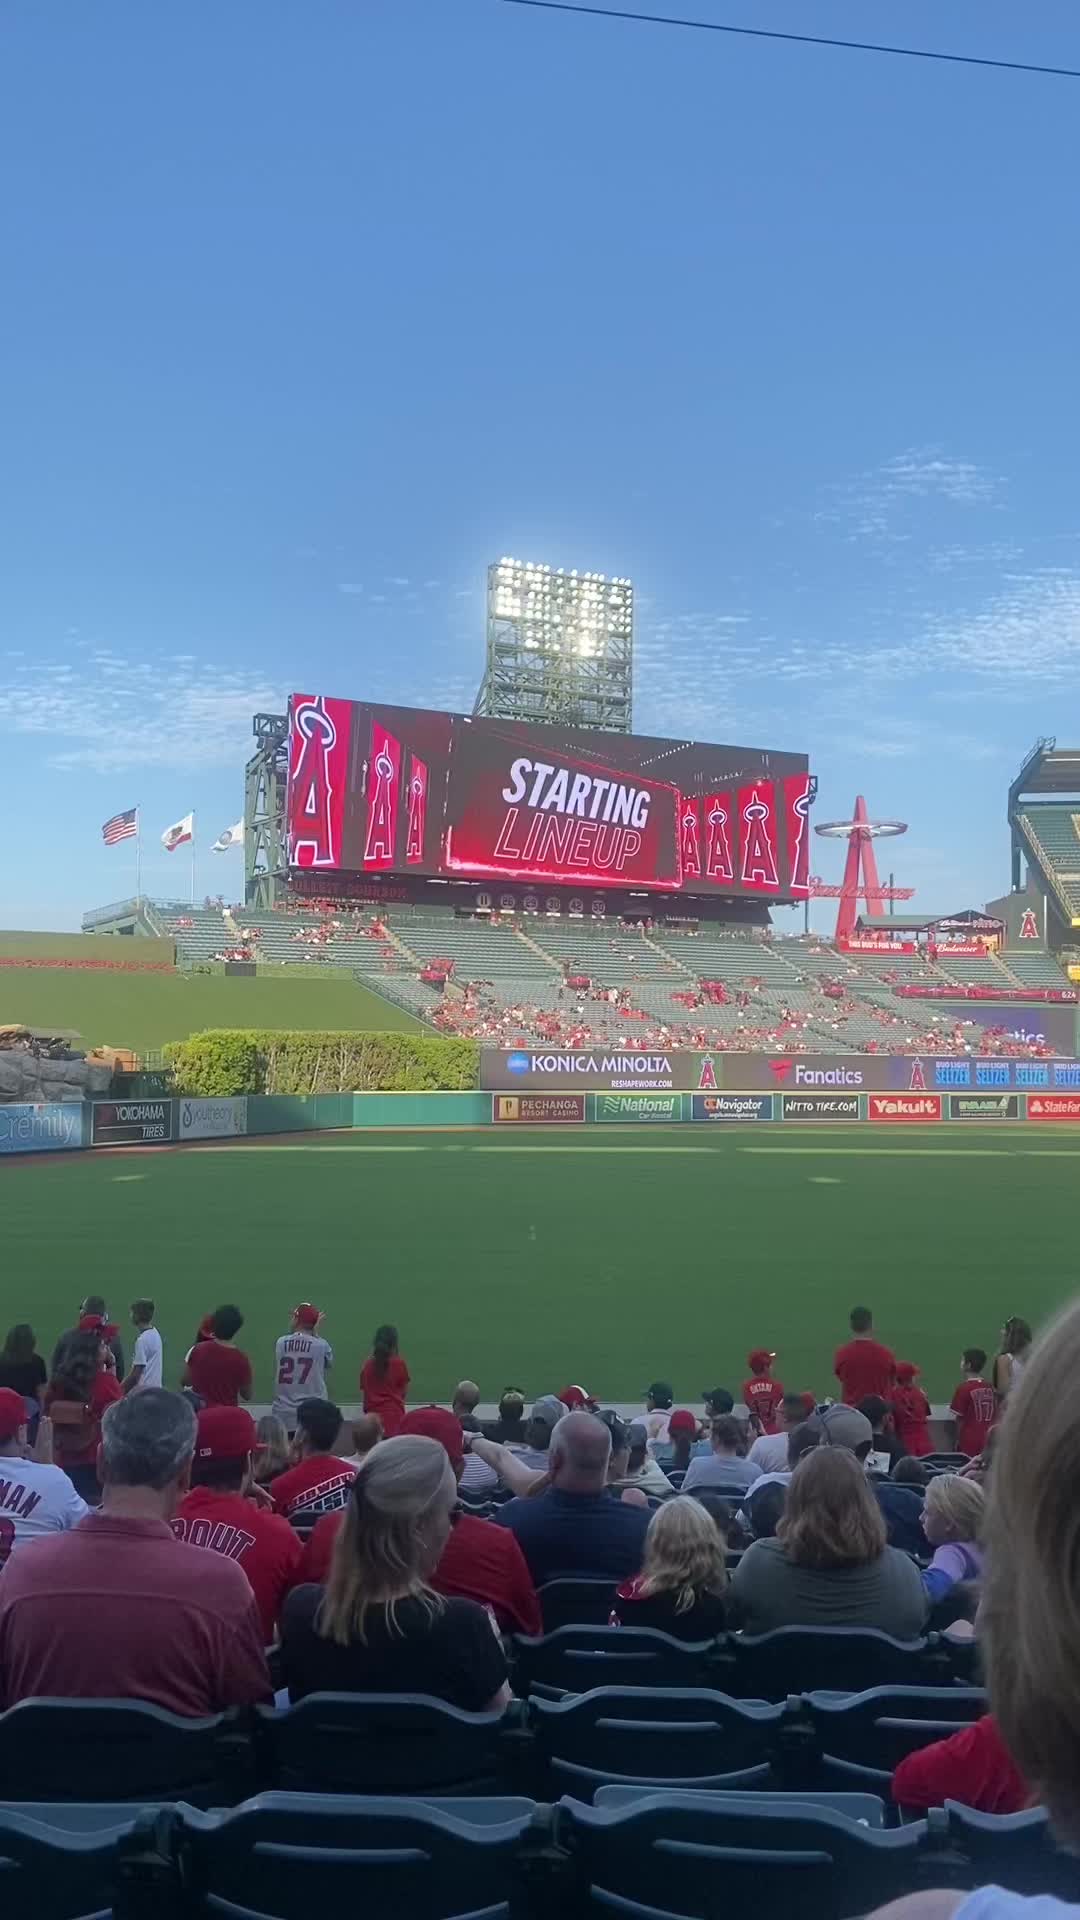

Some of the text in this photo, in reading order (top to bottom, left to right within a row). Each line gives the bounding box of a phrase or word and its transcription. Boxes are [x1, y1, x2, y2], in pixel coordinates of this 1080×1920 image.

[502, 758, 651, 829] STARTING
[494, 807, 641, 870] LINEUP
[532, 1056, 672, 1073] KONICA MINOLTA
[795, 1065, 863, 1084] Fanatics
[611, 1080, 673, 1088] RESHAPEWORK.COM
[521, 1100, 578, 1109] PECHANGA
[619, 1097, 674, 1112] National
[716, 1098, 763, 1112] Navigator
[785, 1100, 857, 1113] NITTO TIRE.COM
[873, 1100, 936, 1114] Yakult
[1044, 1101, 1067, 1112] State
[115, 1105, 165, 1121] YOKOHAMA
[142, 1126, 165, 1138] TIRES
[284, 1339, 313, 1352] TROUT
[279, 1356, 313, 1384] 27
